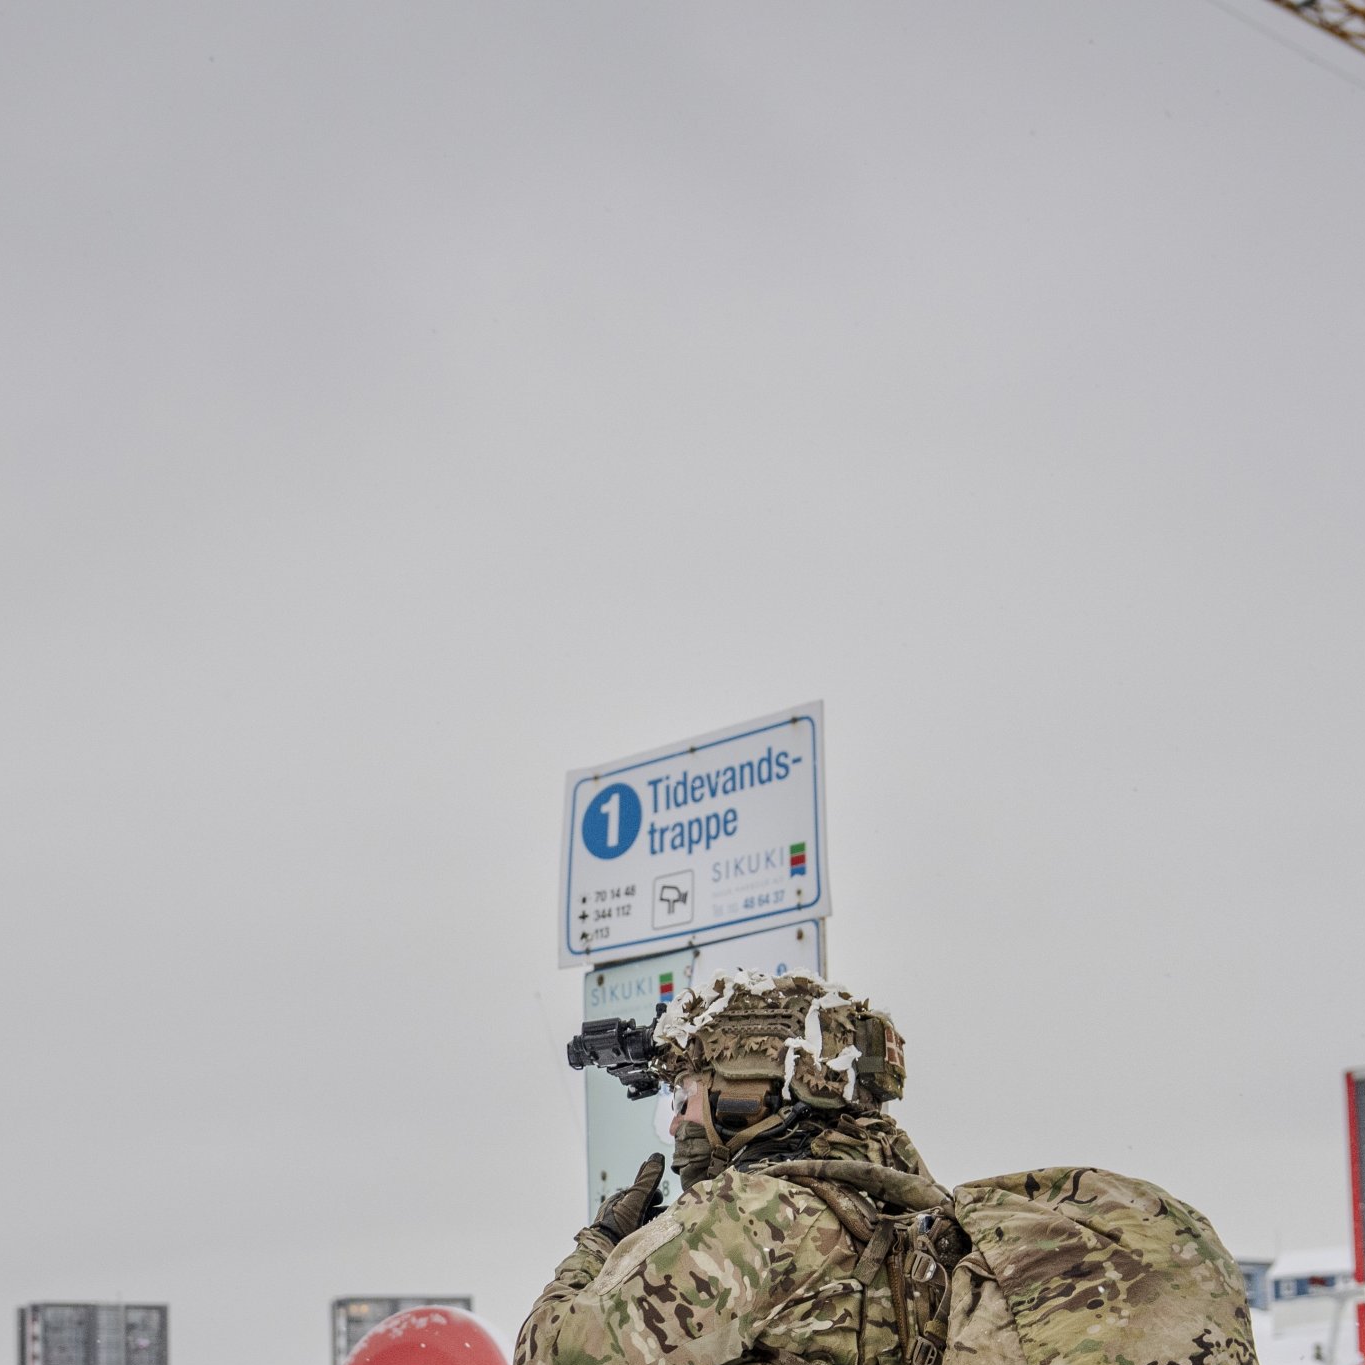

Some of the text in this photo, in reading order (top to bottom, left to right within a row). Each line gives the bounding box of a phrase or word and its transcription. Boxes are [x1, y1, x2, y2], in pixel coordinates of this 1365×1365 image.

[647, 746, 803, 814] Tidevands-
[600, 792, 621, 848] 1
[647, 806, 739, 856] trappe
[711, 846, 785, 883] SIKUKI
[590, 974, 654, 1008] SIKUKI
